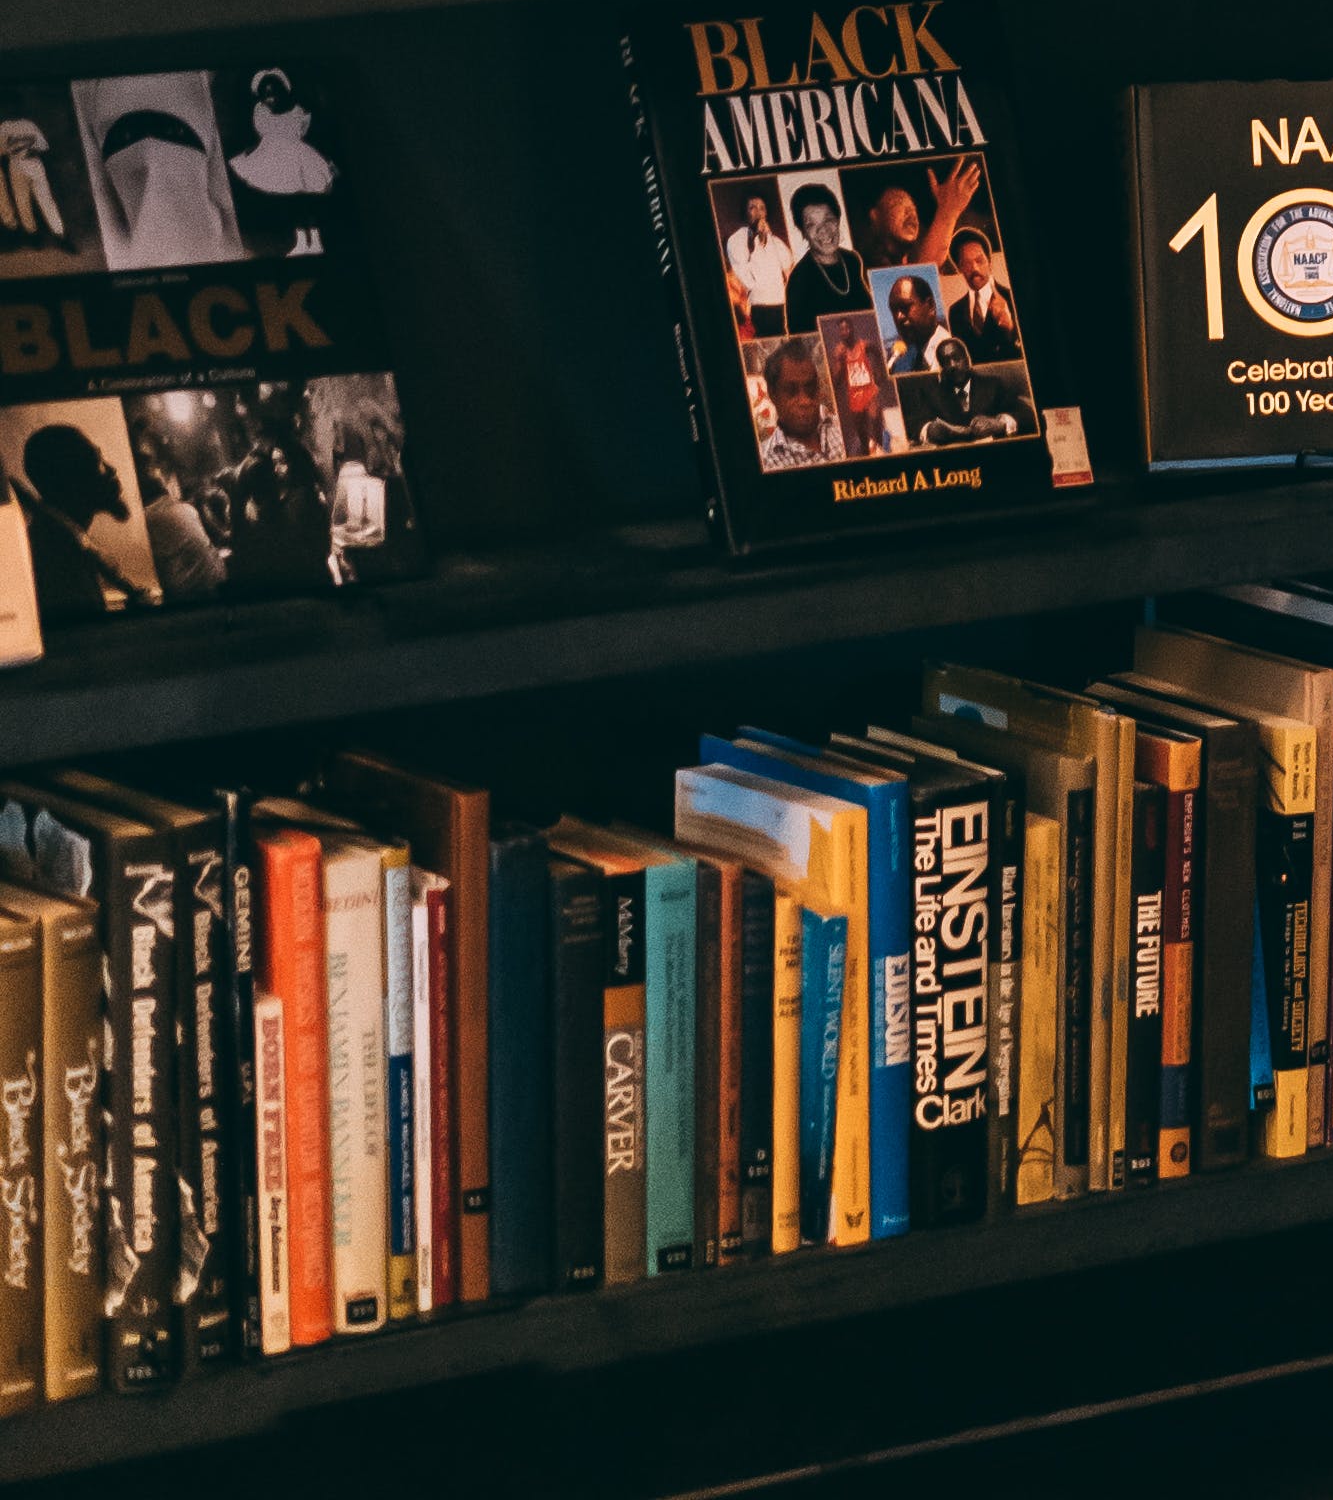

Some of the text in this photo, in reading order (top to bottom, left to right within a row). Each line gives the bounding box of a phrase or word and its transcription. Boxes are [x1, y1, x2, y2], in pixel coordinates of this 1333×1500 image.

[684, 2, 961, 97] BLACK
[701, 76, 988, 174] AMERICANA
[0, 279, 333, 374] BLACK
[1246, 391, 1290, 415] 100
[832, 465, 983, 501] Richard A Long
[915, 809, 941, 1093] The Life and Times
[940, 802, 987, 1090] EINSTEIN
[606, 1031, 635, 1176] CARVER
[915, 1093, 986, 1128] Clark
